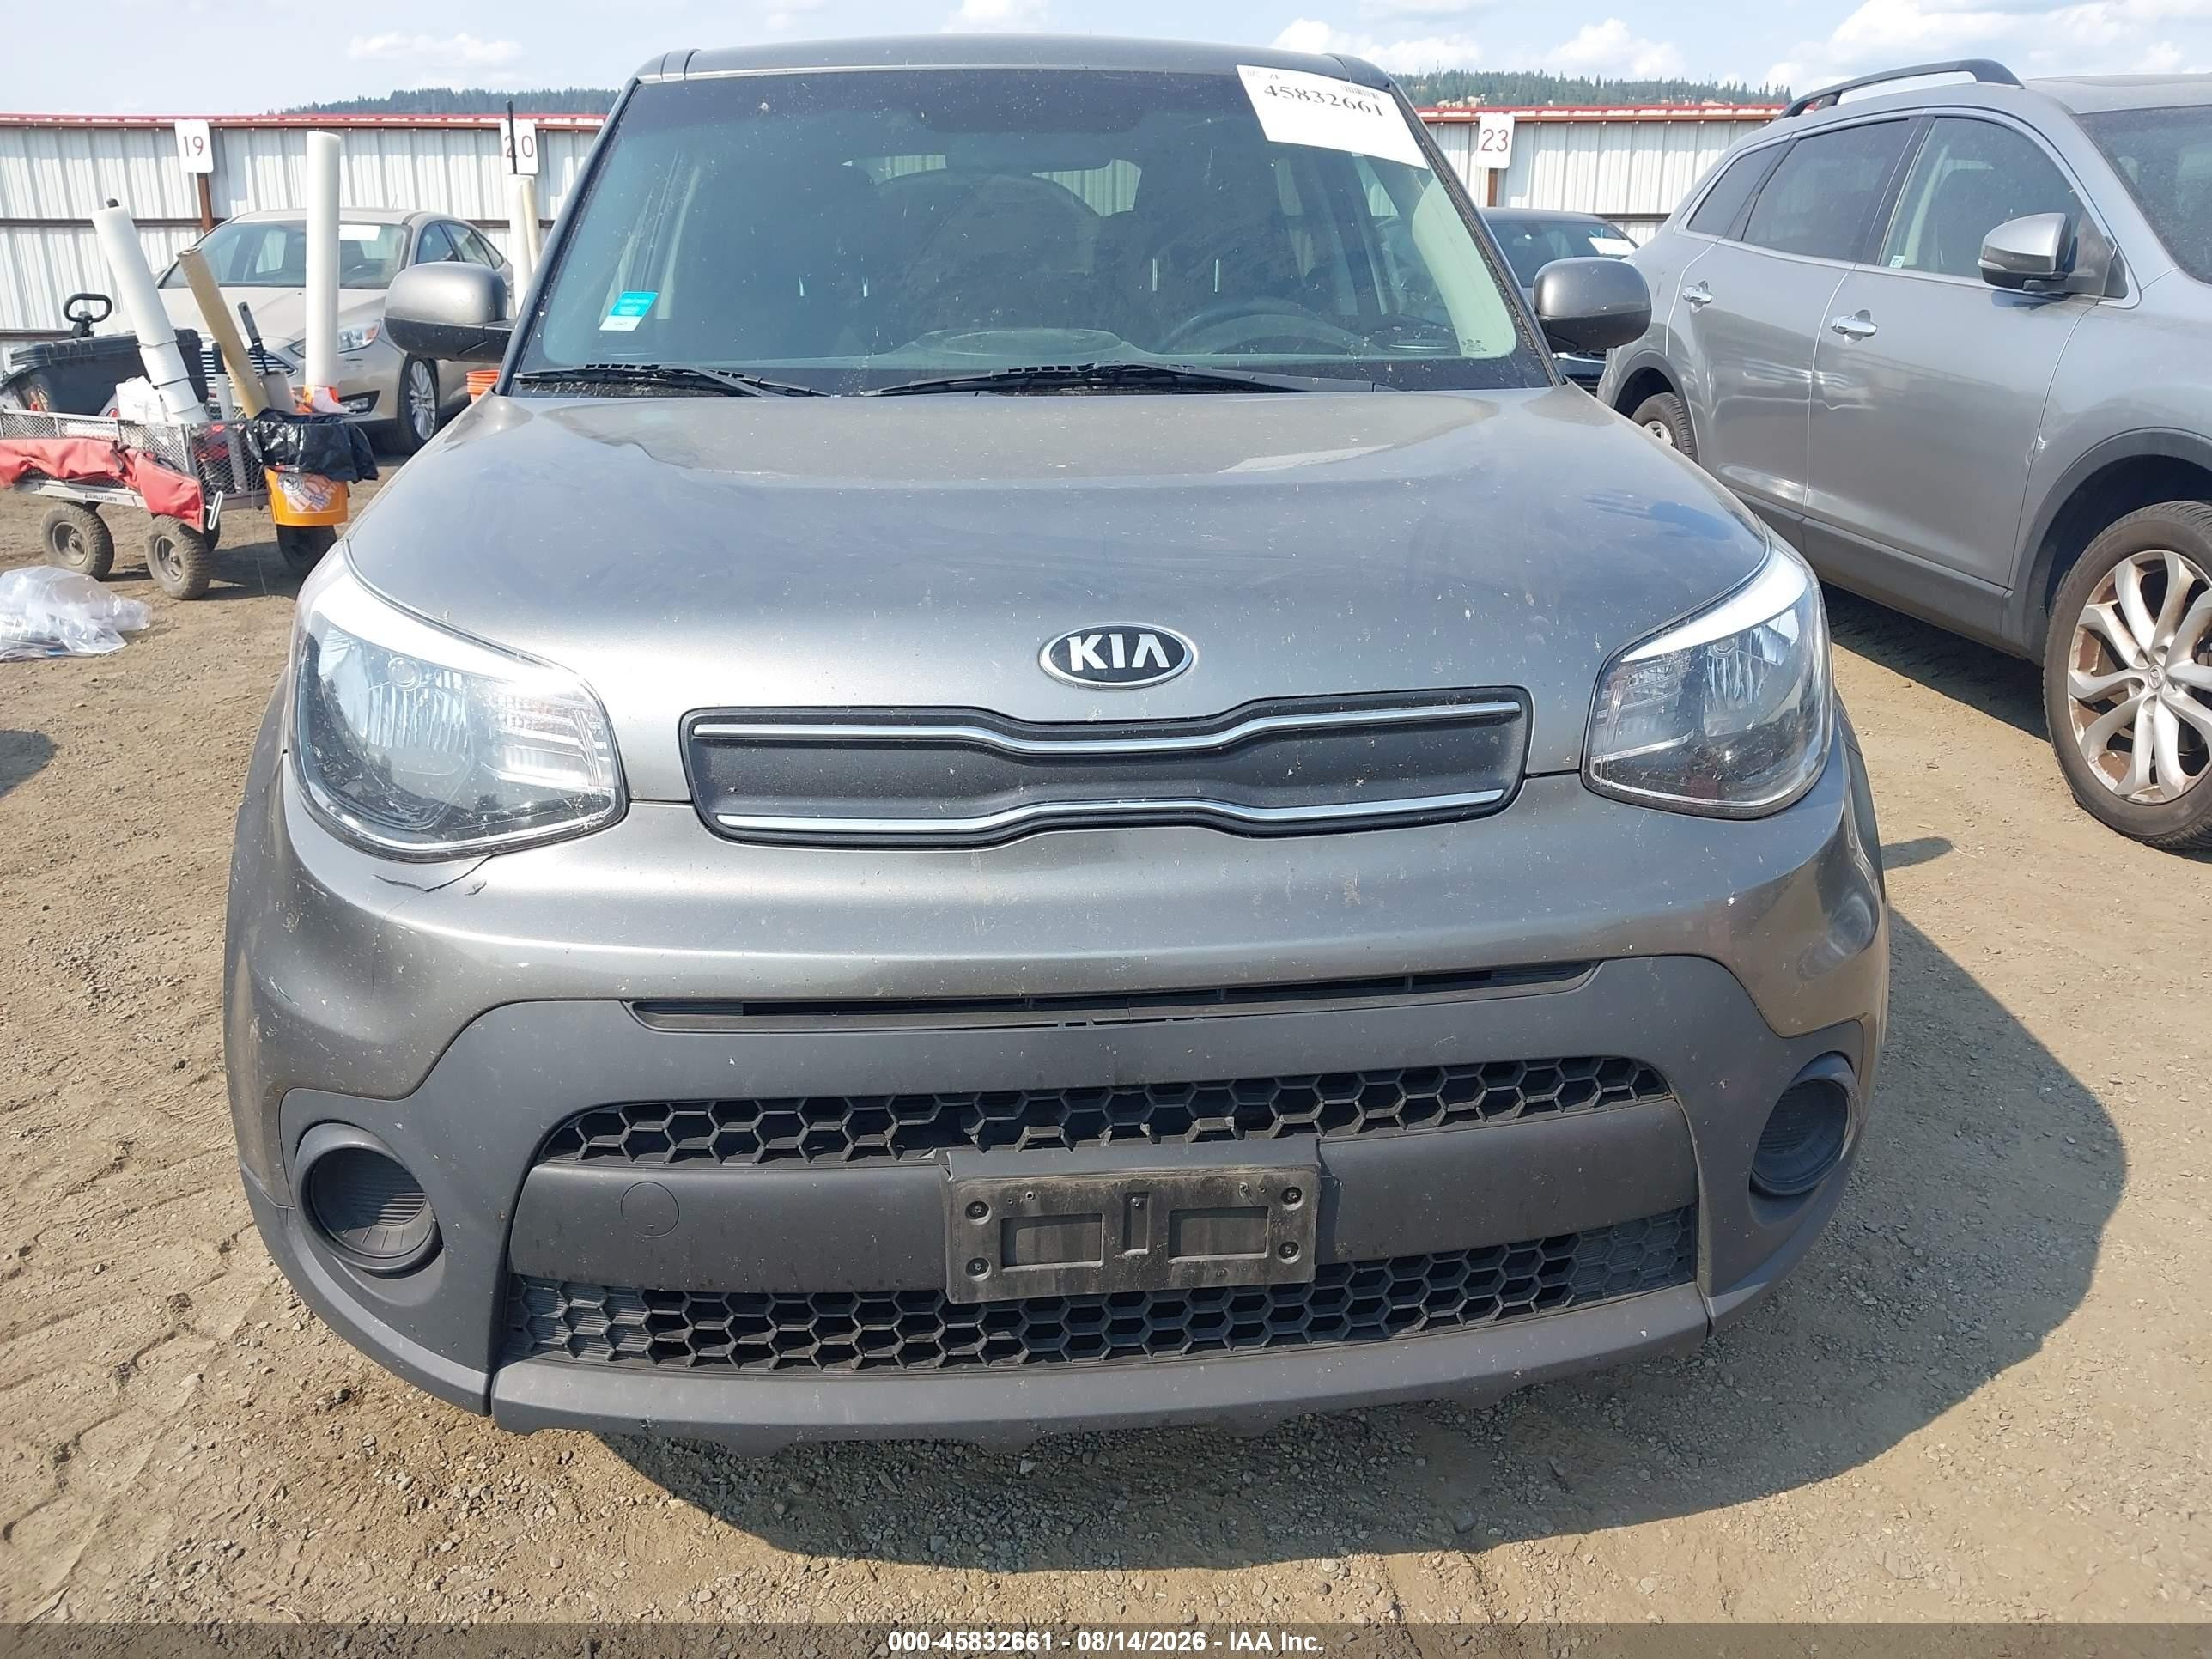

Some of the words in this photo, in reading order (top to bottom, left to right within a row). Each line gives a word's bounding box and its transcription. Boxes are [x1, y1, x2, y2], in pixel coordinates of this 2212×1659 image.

[1264, 84, 1384, 117] 45832661
[183, 135, 204, 157] 19
[1481, 129, 1509, 152] 23
[1067, 634, 1170, 671] KIA
